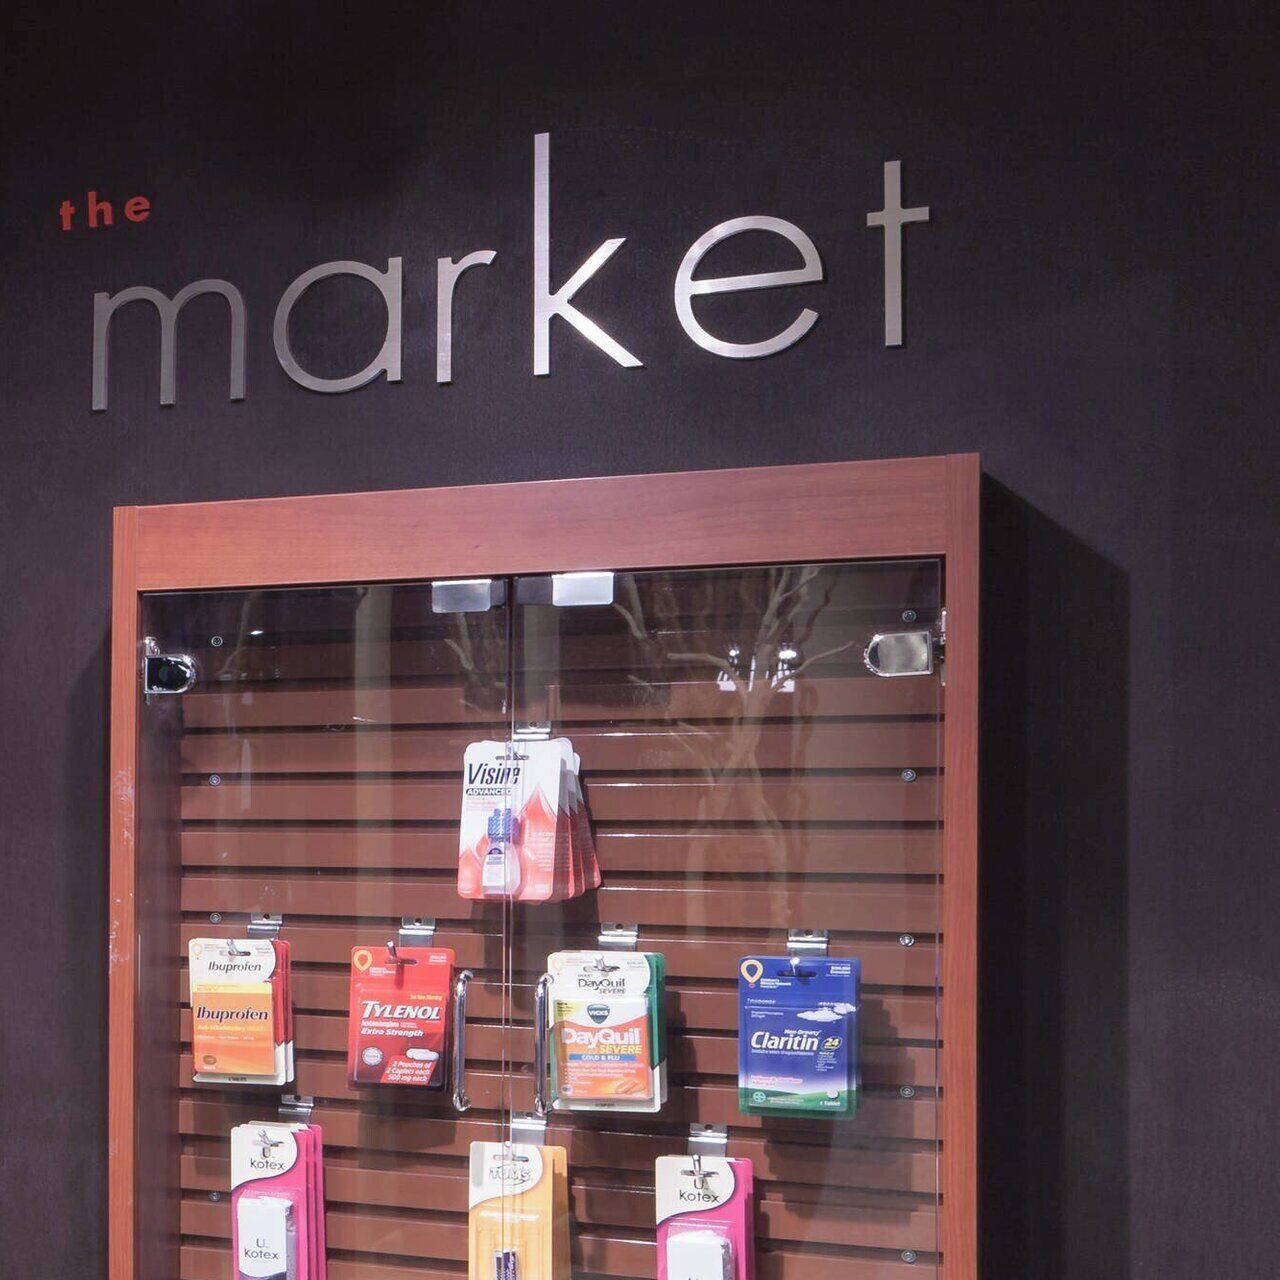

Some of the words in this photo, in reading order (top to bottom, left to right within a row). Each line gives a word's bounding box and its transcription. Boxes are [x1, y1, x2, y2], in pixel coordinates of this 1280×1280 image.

[58, 190, 151, 232] the
[91, 132, 930, 413] market
[468, 762, 521, 785] Visine
[208, 960, 263, 975] Ibuprofen
[578, 978, 626, 991] DayQuil
[196, 1006, 270, 1024] Ibuprofen
[361, 1000, 441, 1020] TYLENOL
[588, 1009, 609, 1017] VICKS
[361, 1028, 385, 1036] Extra
[386, 1028, 425, 1038] Strength
[562, 1027, 641, 1050] DayQuil
[751, 1031, 819, 1051] Claritin
[824, 1037, 840, 1047] 24
[599, 1045, 642, 1055] SEVERE
